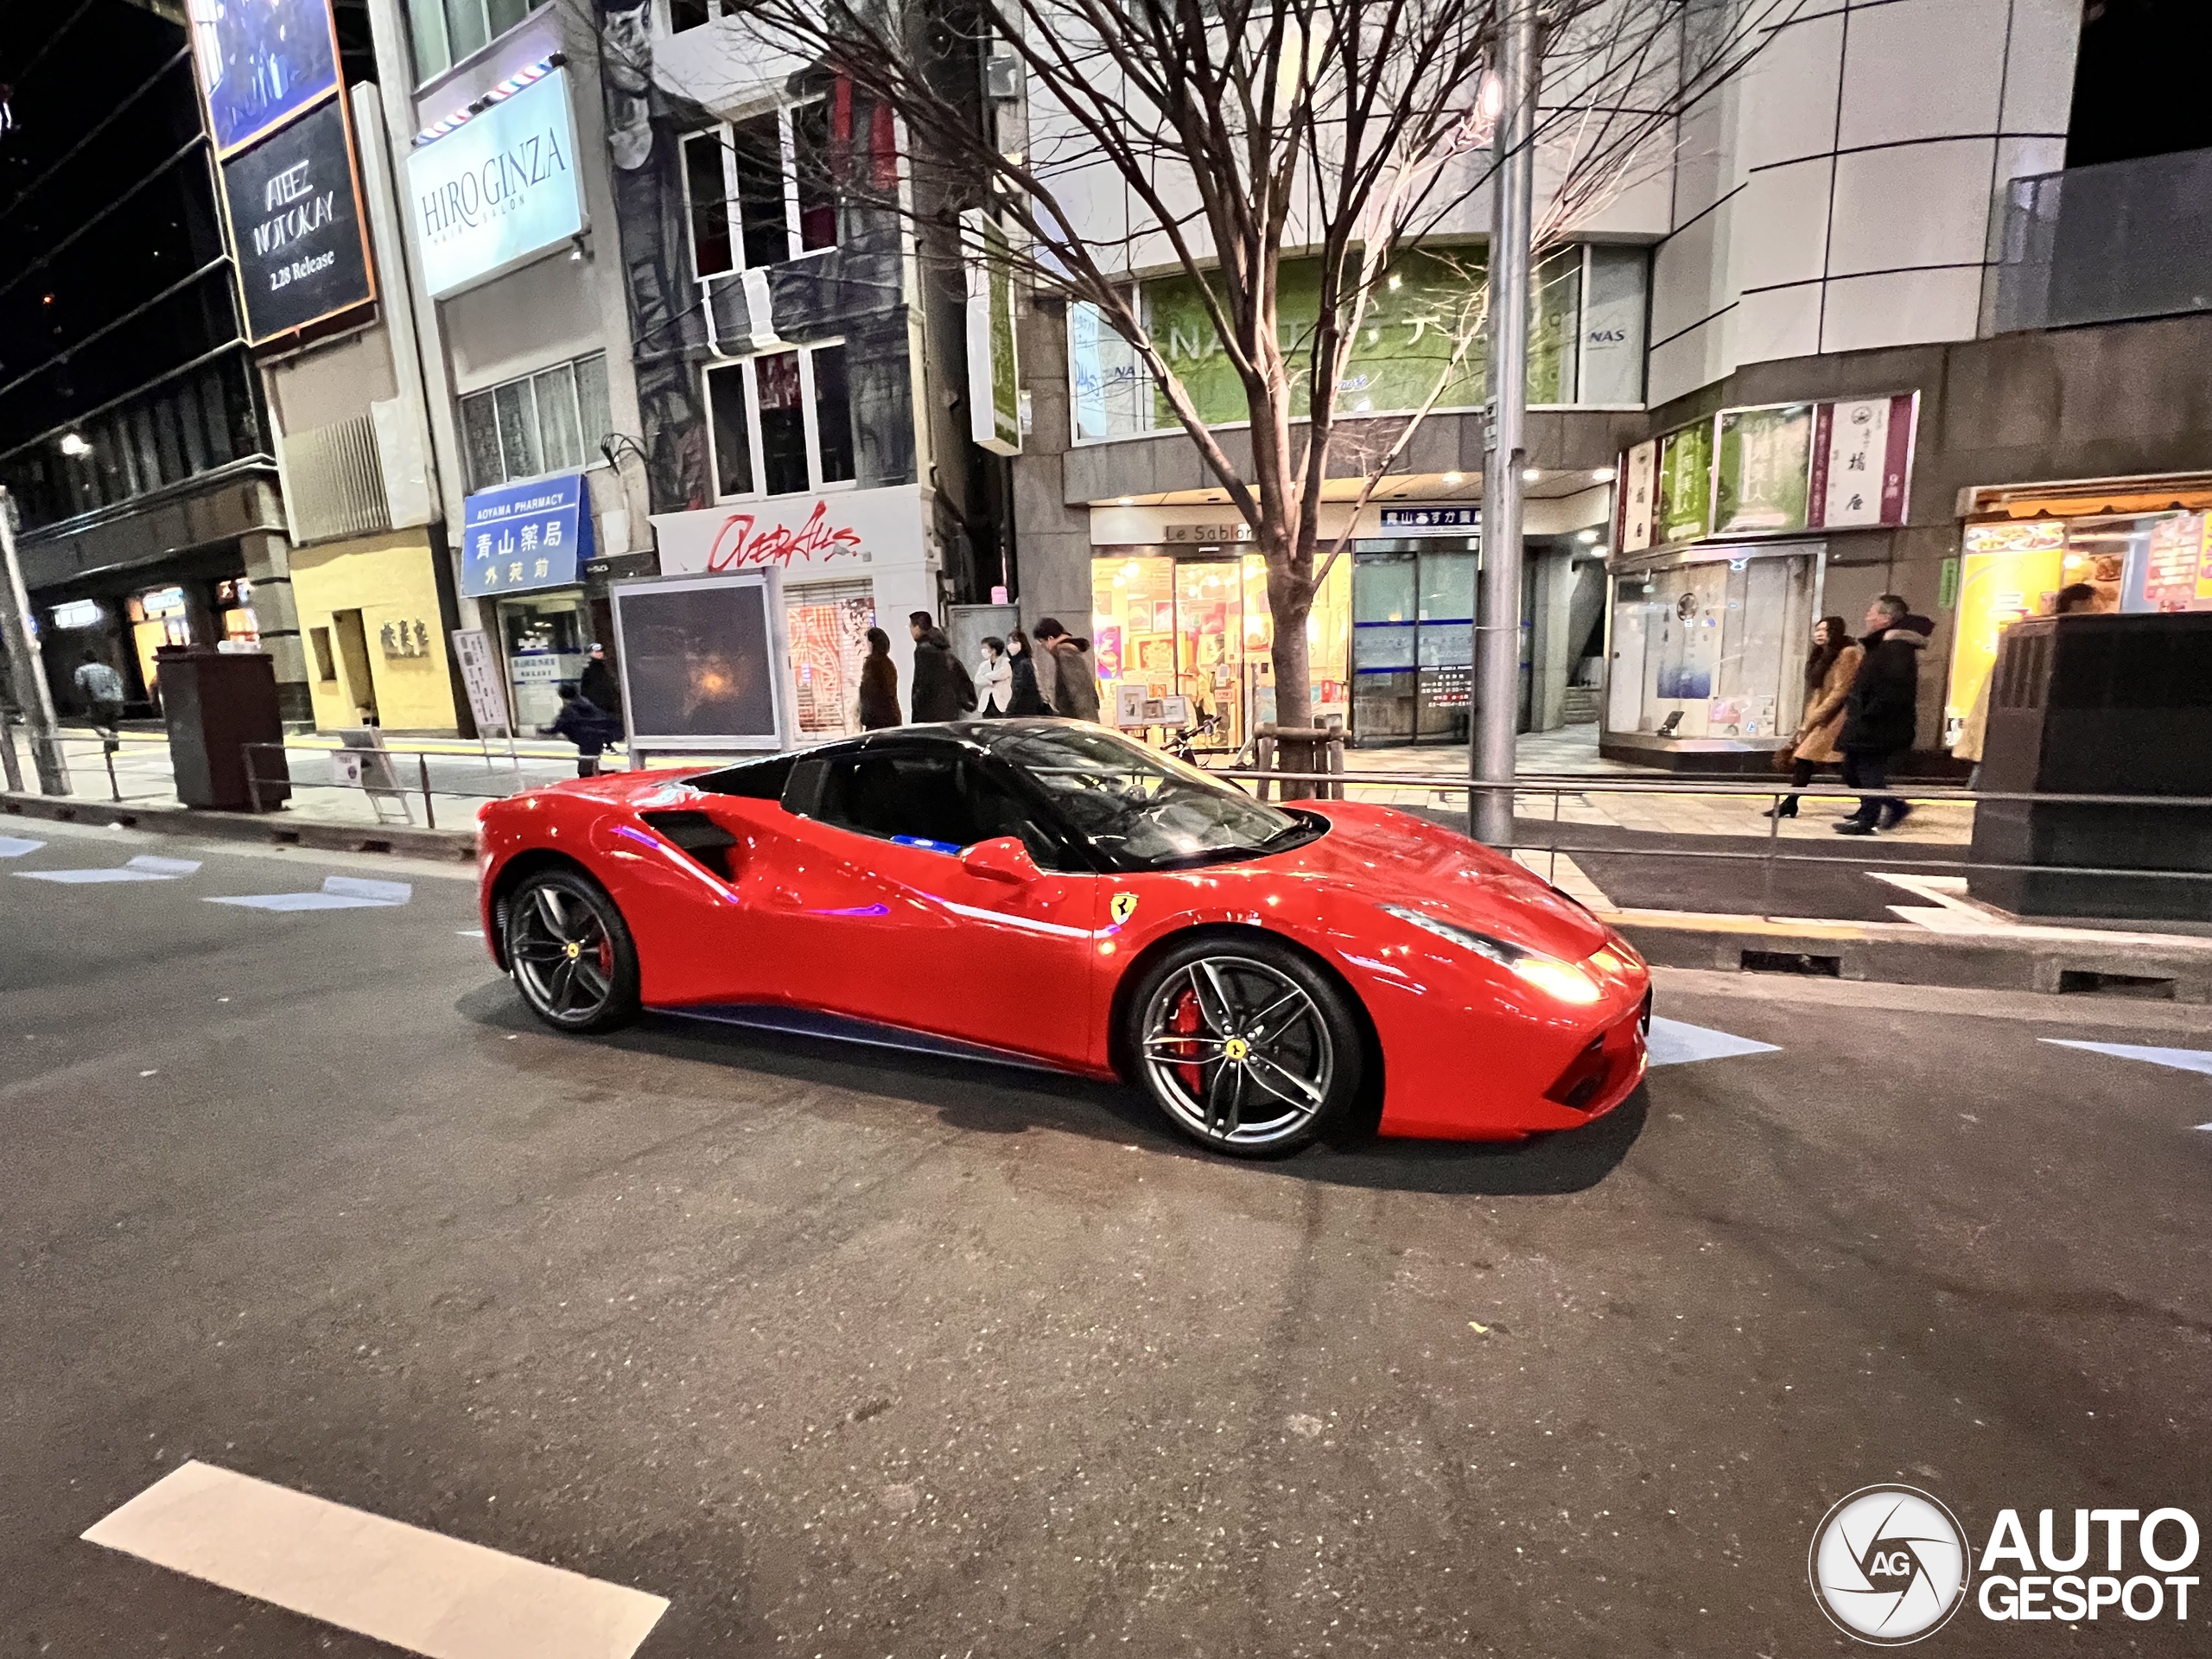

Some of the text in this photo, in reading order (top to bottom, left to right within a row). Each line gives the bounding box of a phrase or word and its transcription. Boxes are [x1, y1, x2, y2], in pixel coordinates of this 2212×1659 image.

[265, 160, 314, 212] ATEEZ
[422, 127, 566, 236] HIRO GINZA
[482, 194, 525, 224] SALON
[292, 251, 335, 280] Release
[1589, 329, 1625, 342] NAS
[477, 493, 564, 520] AOYAMA PHARMACY
[1166, 525, 1186, 541] Le
